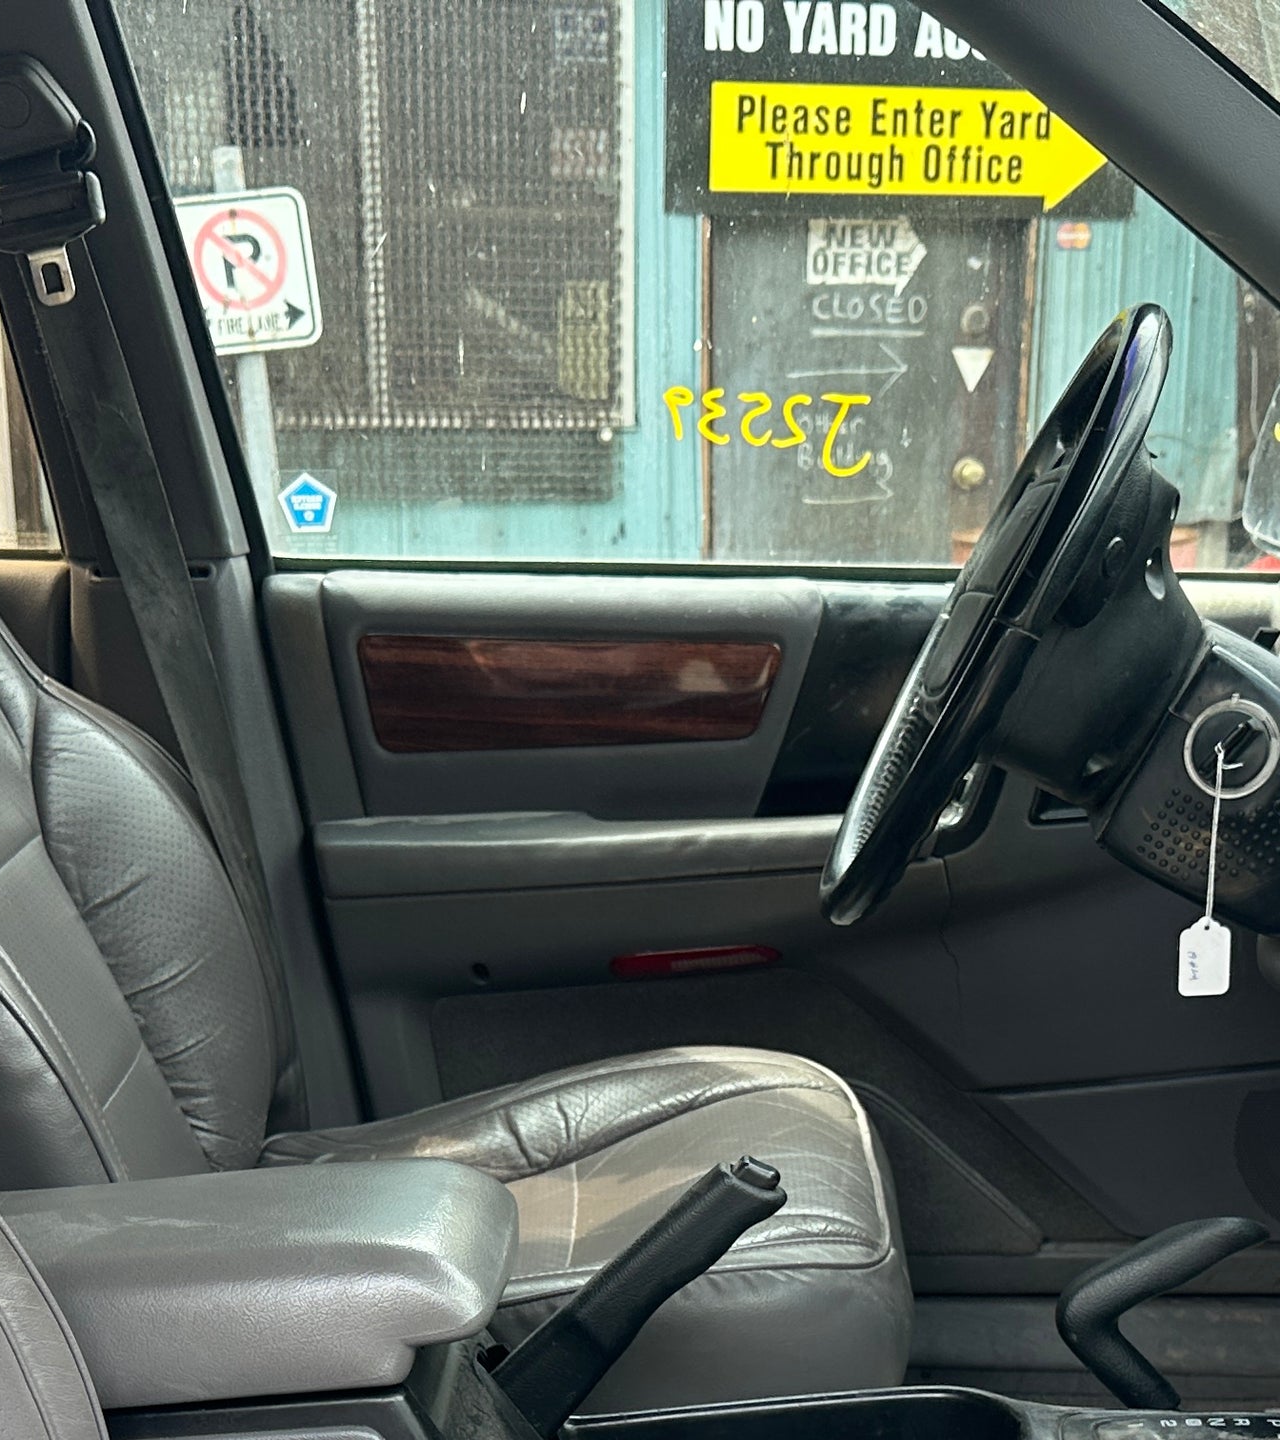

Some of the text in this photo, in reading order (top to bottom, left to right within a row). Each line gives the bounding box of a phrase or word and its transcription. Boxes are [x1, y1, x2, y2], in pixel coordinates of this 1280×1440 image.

[704, 0, 764, 53] NO
[783, 0, 897, 56] YARD
[737, 95, 1051, 140] Please Enter Yard
[765, 141, 1023, 189] Through Office
[826, 224, 897, 249] NEW
[811, 250, 911, 278] OFFICE
[811, 292, 929, 325] CLOSED
